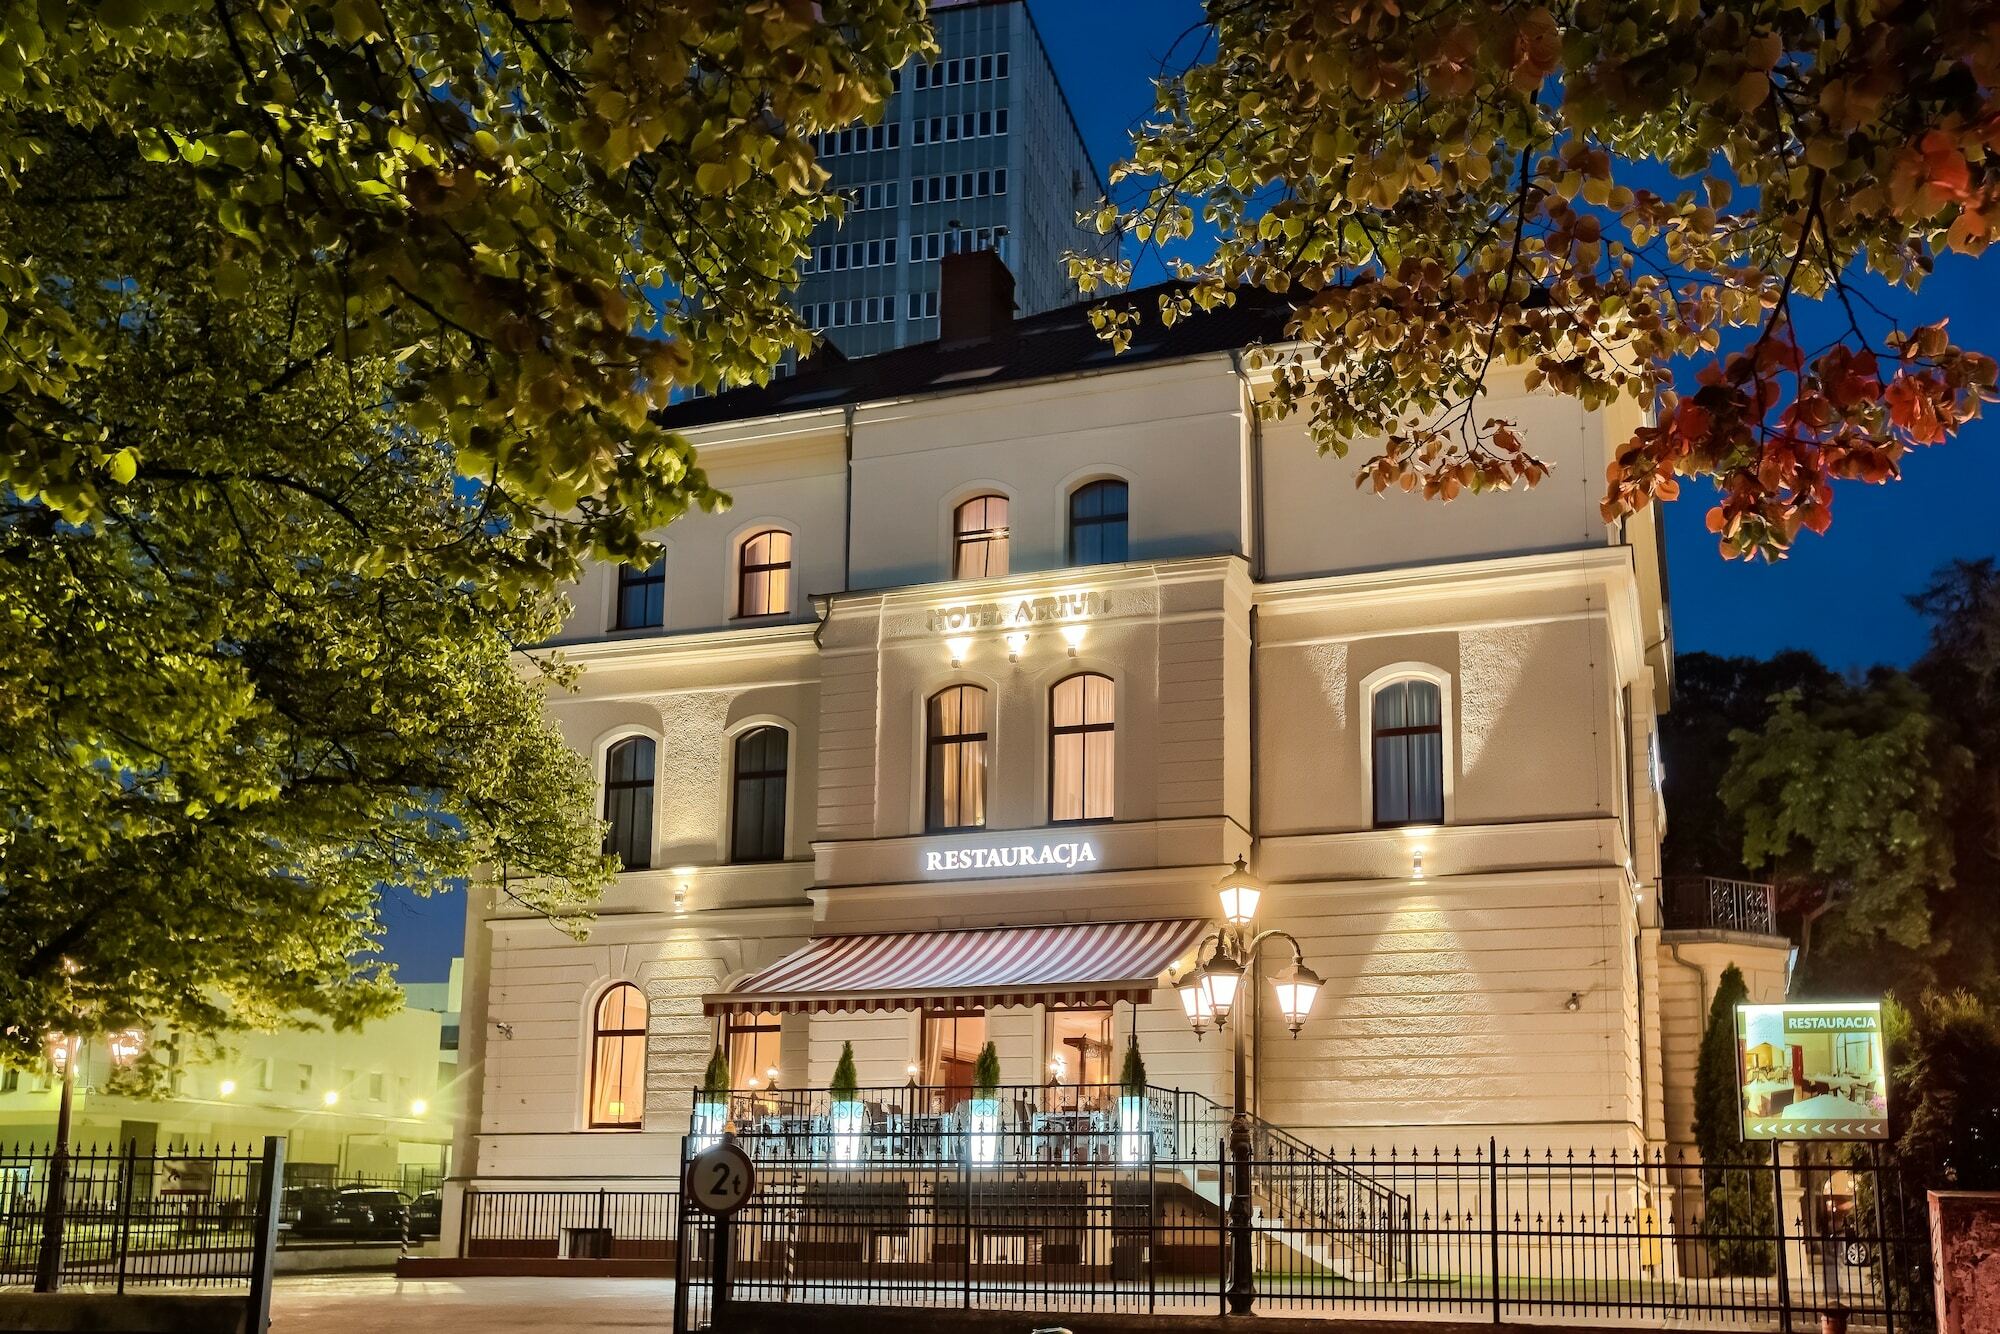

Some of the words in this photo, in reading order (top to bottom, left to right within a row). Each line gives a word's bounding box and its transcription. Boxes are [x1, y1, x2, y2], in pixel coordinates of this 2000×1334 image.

[926, 602, 1003, 632] HOTEL
[1014, 590, 1114, 623] ATRIUM
[926, 842, 1096, 871] RESTAURACJA
[1788, 1016, 1877, 1029] RESTAURACJA
